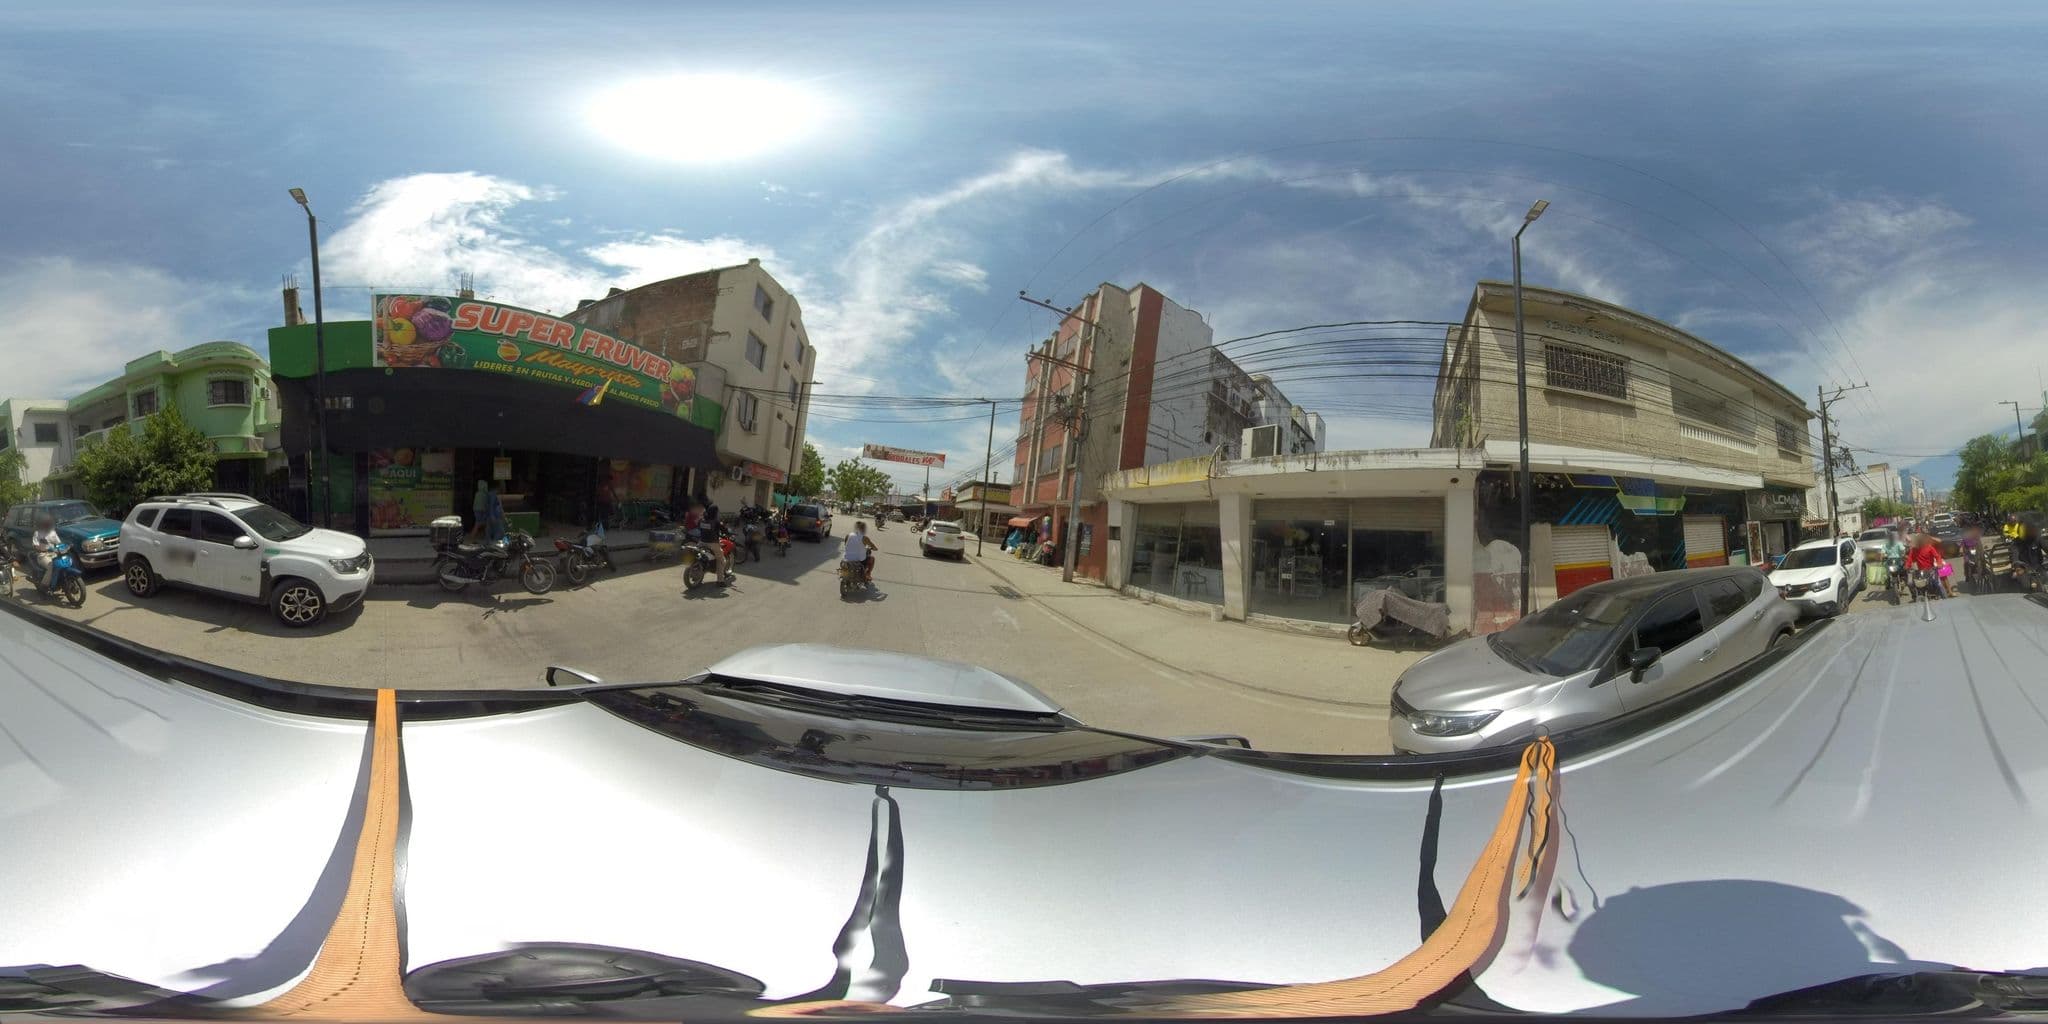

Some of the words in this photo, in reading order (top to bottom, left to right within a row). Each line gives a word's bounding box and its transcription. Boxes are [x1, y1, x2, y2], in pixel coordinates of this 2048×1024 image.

[452, 301, 575, 350] SUPER
[576, 328, 673, 383] FRUVER
[516, 366, 529, 375] EN
[531, 368, 564, 382] FRUTAS
